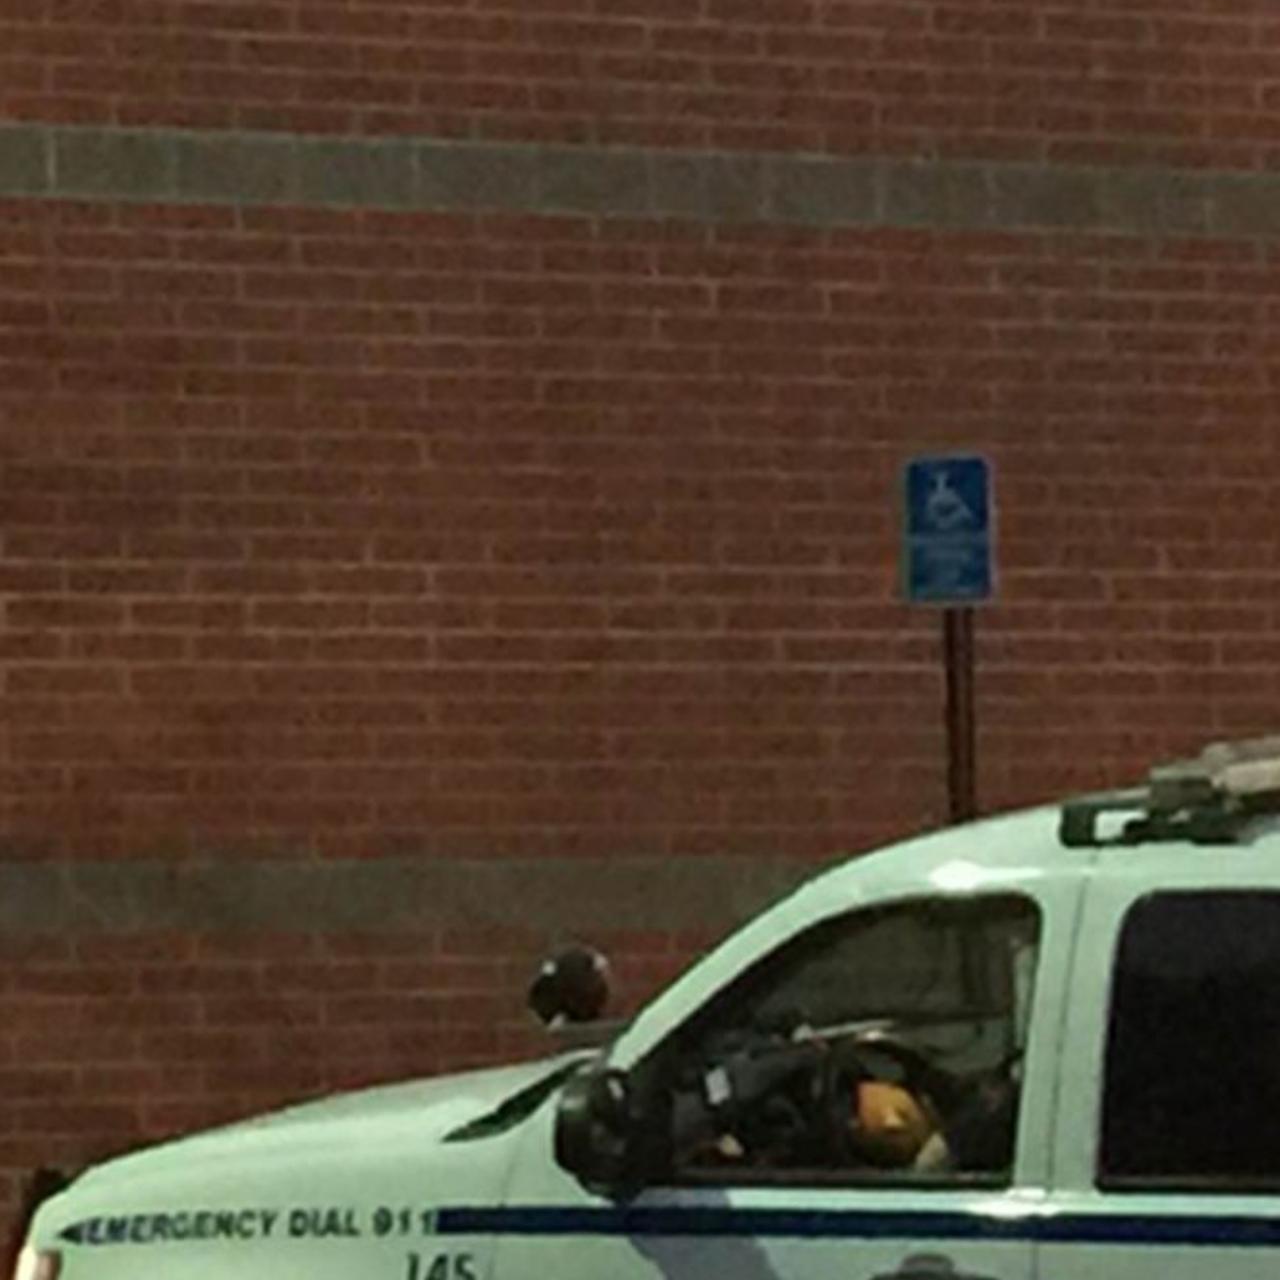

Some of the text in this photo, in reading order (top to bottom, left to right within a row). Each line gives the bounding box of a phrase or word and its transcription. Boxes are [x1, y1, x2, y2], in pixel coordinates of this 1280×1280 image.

[87, 1206, 437, 1246] EMERGENCY DIAL 911
